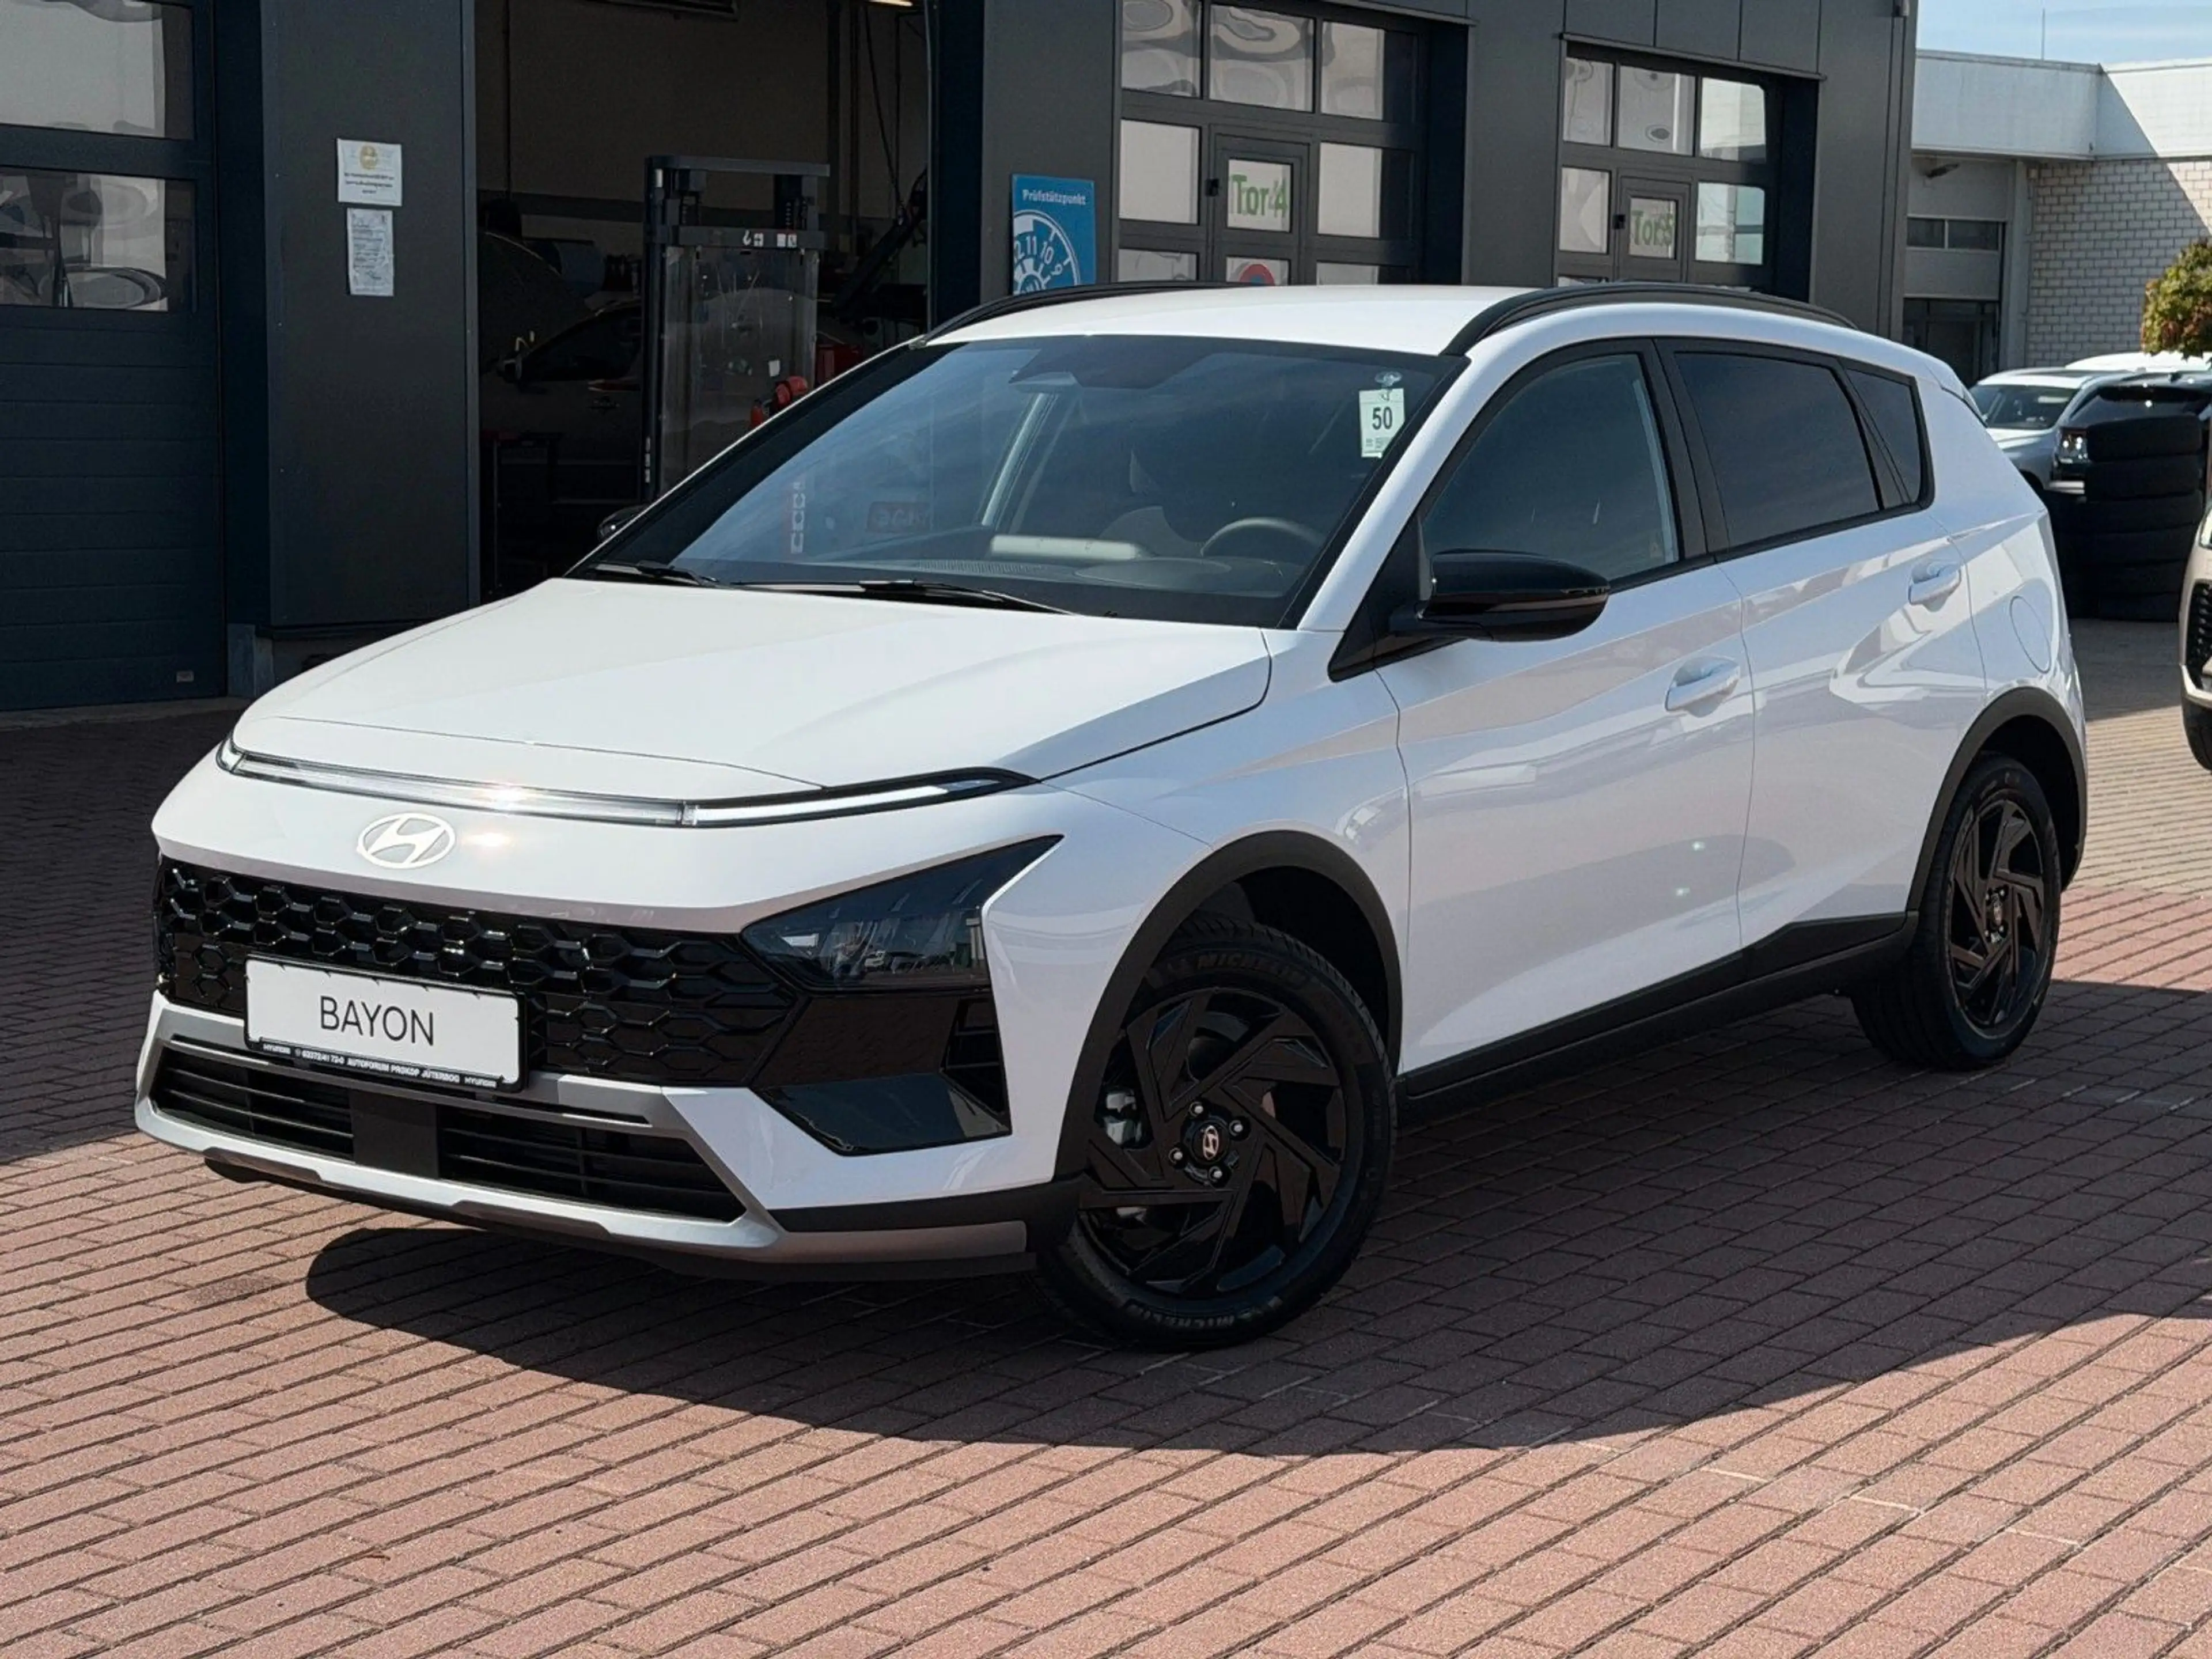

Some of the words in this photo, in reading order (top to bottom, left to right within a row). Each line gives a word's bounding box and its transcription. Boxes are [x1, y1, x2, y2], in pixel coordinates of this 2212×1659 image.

[1022, 188, 1086, 206] Prüfstützpunkt
[1230, 174, 1269, 217] Tor
[1272, 176, 1288, 219] 4
[1025, 234, 1037, 255] 11
[1040, 240, 1054, 265] 10
[1050, 260, 1063, 276] 9
[1372, 406, 1392, 430] 50
[319, 995, 434, 1046] BAYON
